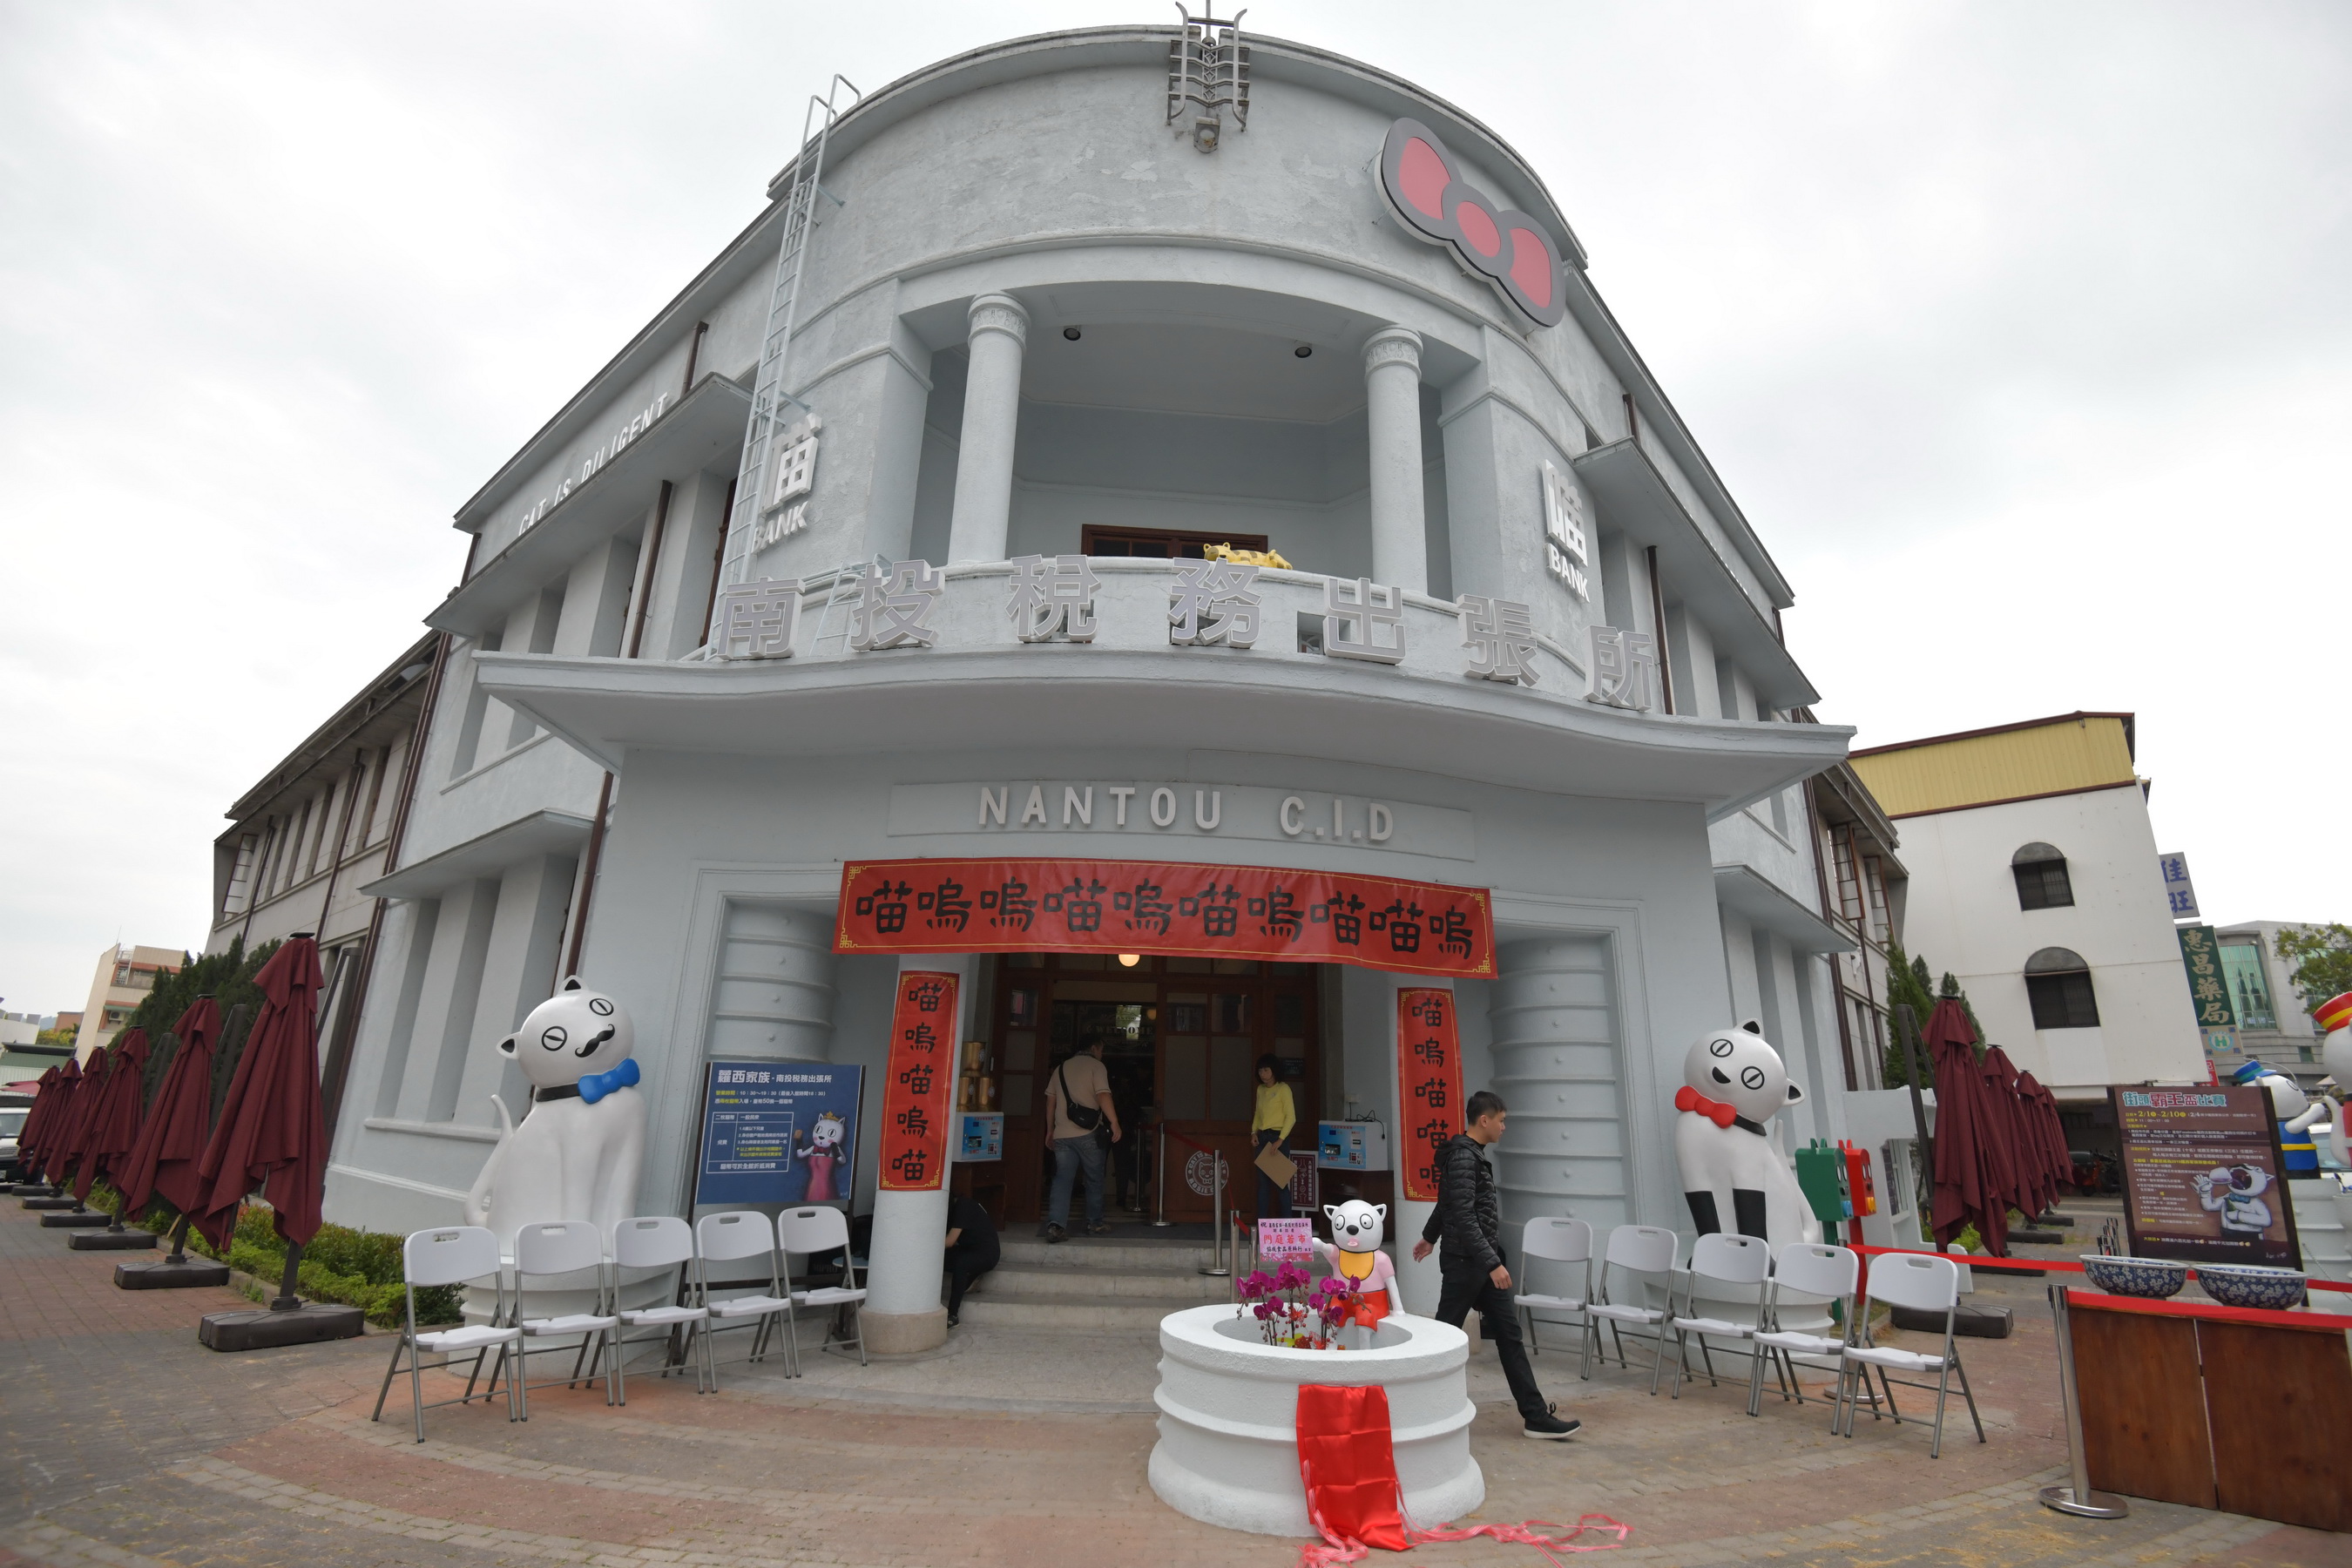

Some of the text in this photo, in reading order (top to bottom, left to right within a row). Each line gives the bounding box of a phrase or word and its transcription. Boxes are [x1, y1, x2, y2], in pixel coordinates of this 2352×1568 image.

[518, 498, 547, 537] CAT
[751, 500, 809, 555] BANK
[1544, 542, 1591, 604] BANK
[978, 786, 1395, 841] NANTOU C.I.D
[2182, 929, 2230, 1024] 惠昌藥局
[891, 982, 943, 1181] 喵嗚喵嗚喵
[1188, 1157, 1198, 1168] CAT
[1263, 1234, 1307, 1245] 門庭若市
